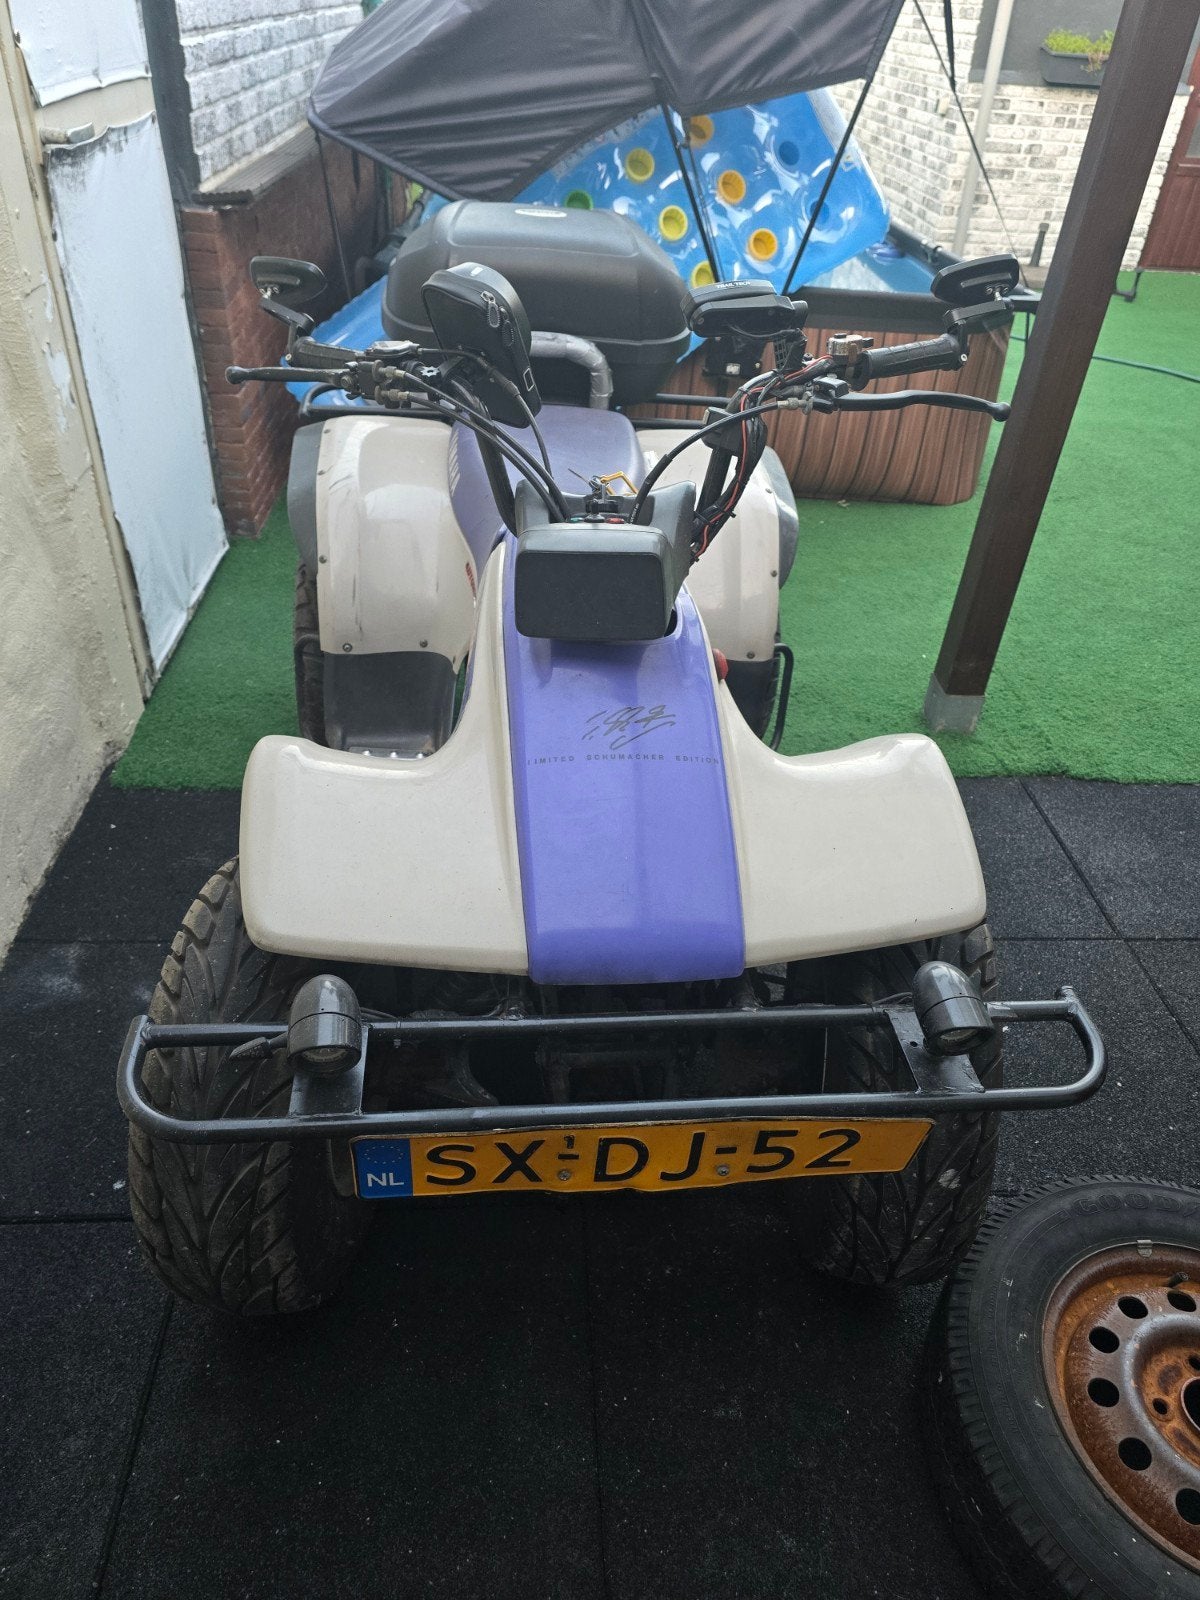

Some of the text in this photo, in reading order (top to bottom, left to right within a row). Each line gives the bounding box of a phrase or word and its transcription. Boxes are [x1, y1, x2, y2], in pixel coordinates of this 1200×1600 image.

[586, 753, 666, 762] SCHUMACHER
[675, 754, 720, 765] EDITION
[426, 1128, 861, 1186] SX-DJ-52
[366, 1172, 405, 1188] NL
